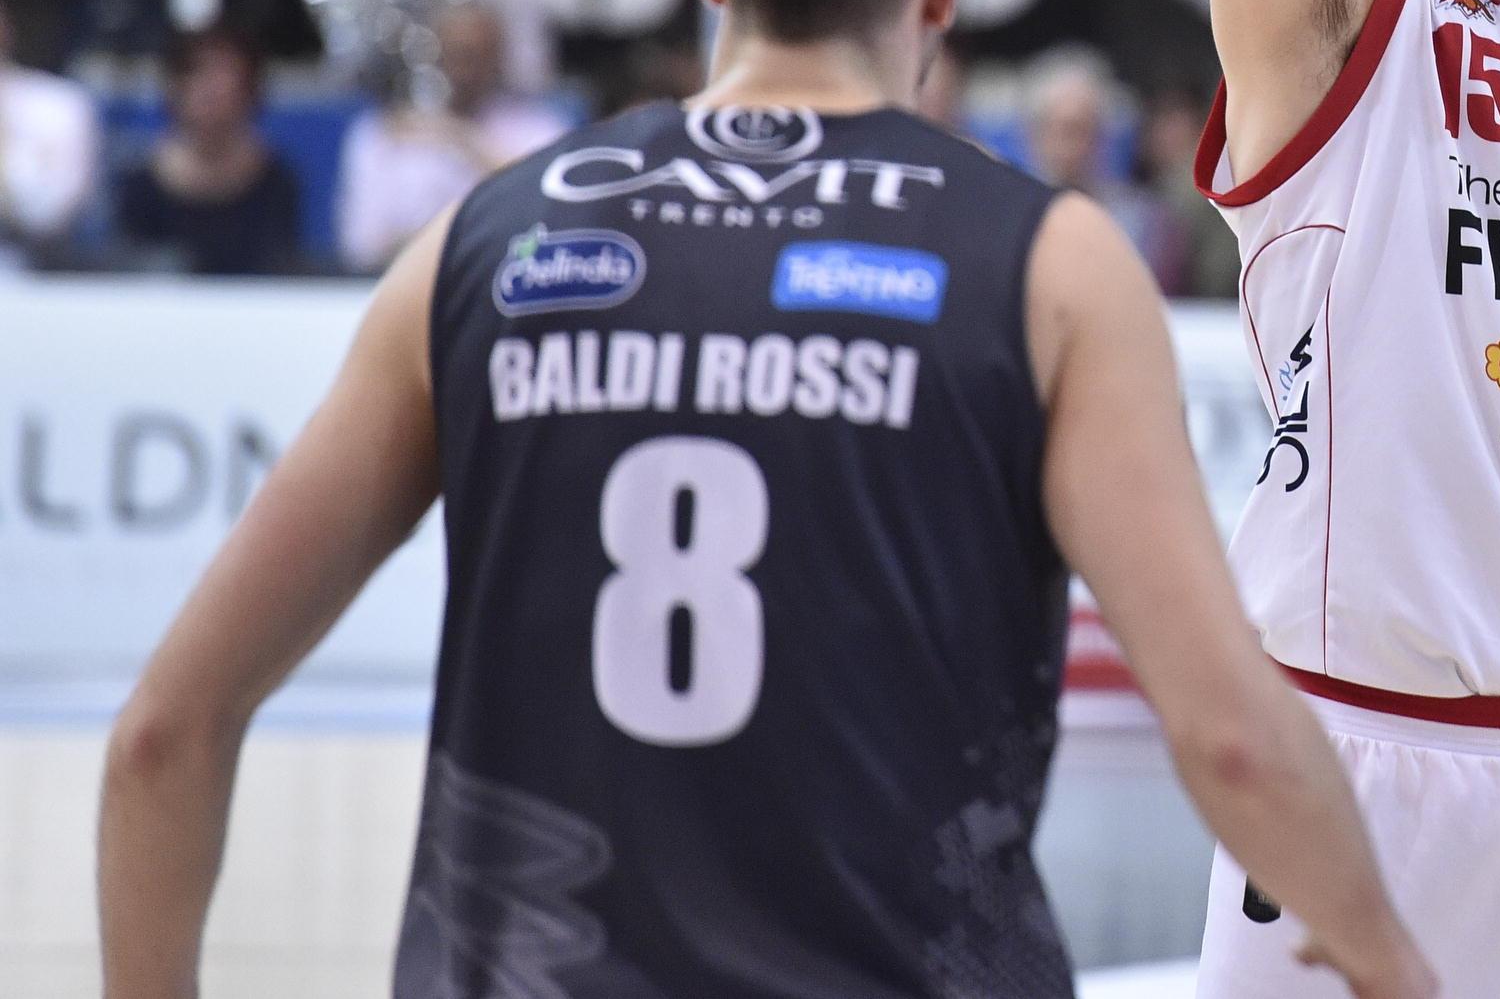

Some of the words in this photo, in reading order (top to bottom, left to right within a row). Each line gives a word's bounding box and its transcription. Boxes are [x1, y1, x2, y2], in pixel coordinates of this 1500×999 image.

[541, 146, 945, 209] CAVIT
[630, 200, 824, 227] TRENTO
[489, 331, 685, 422] BALDI
[695, 336, 919, 430] ROSSI
[592, 436, 769, 748] 8
